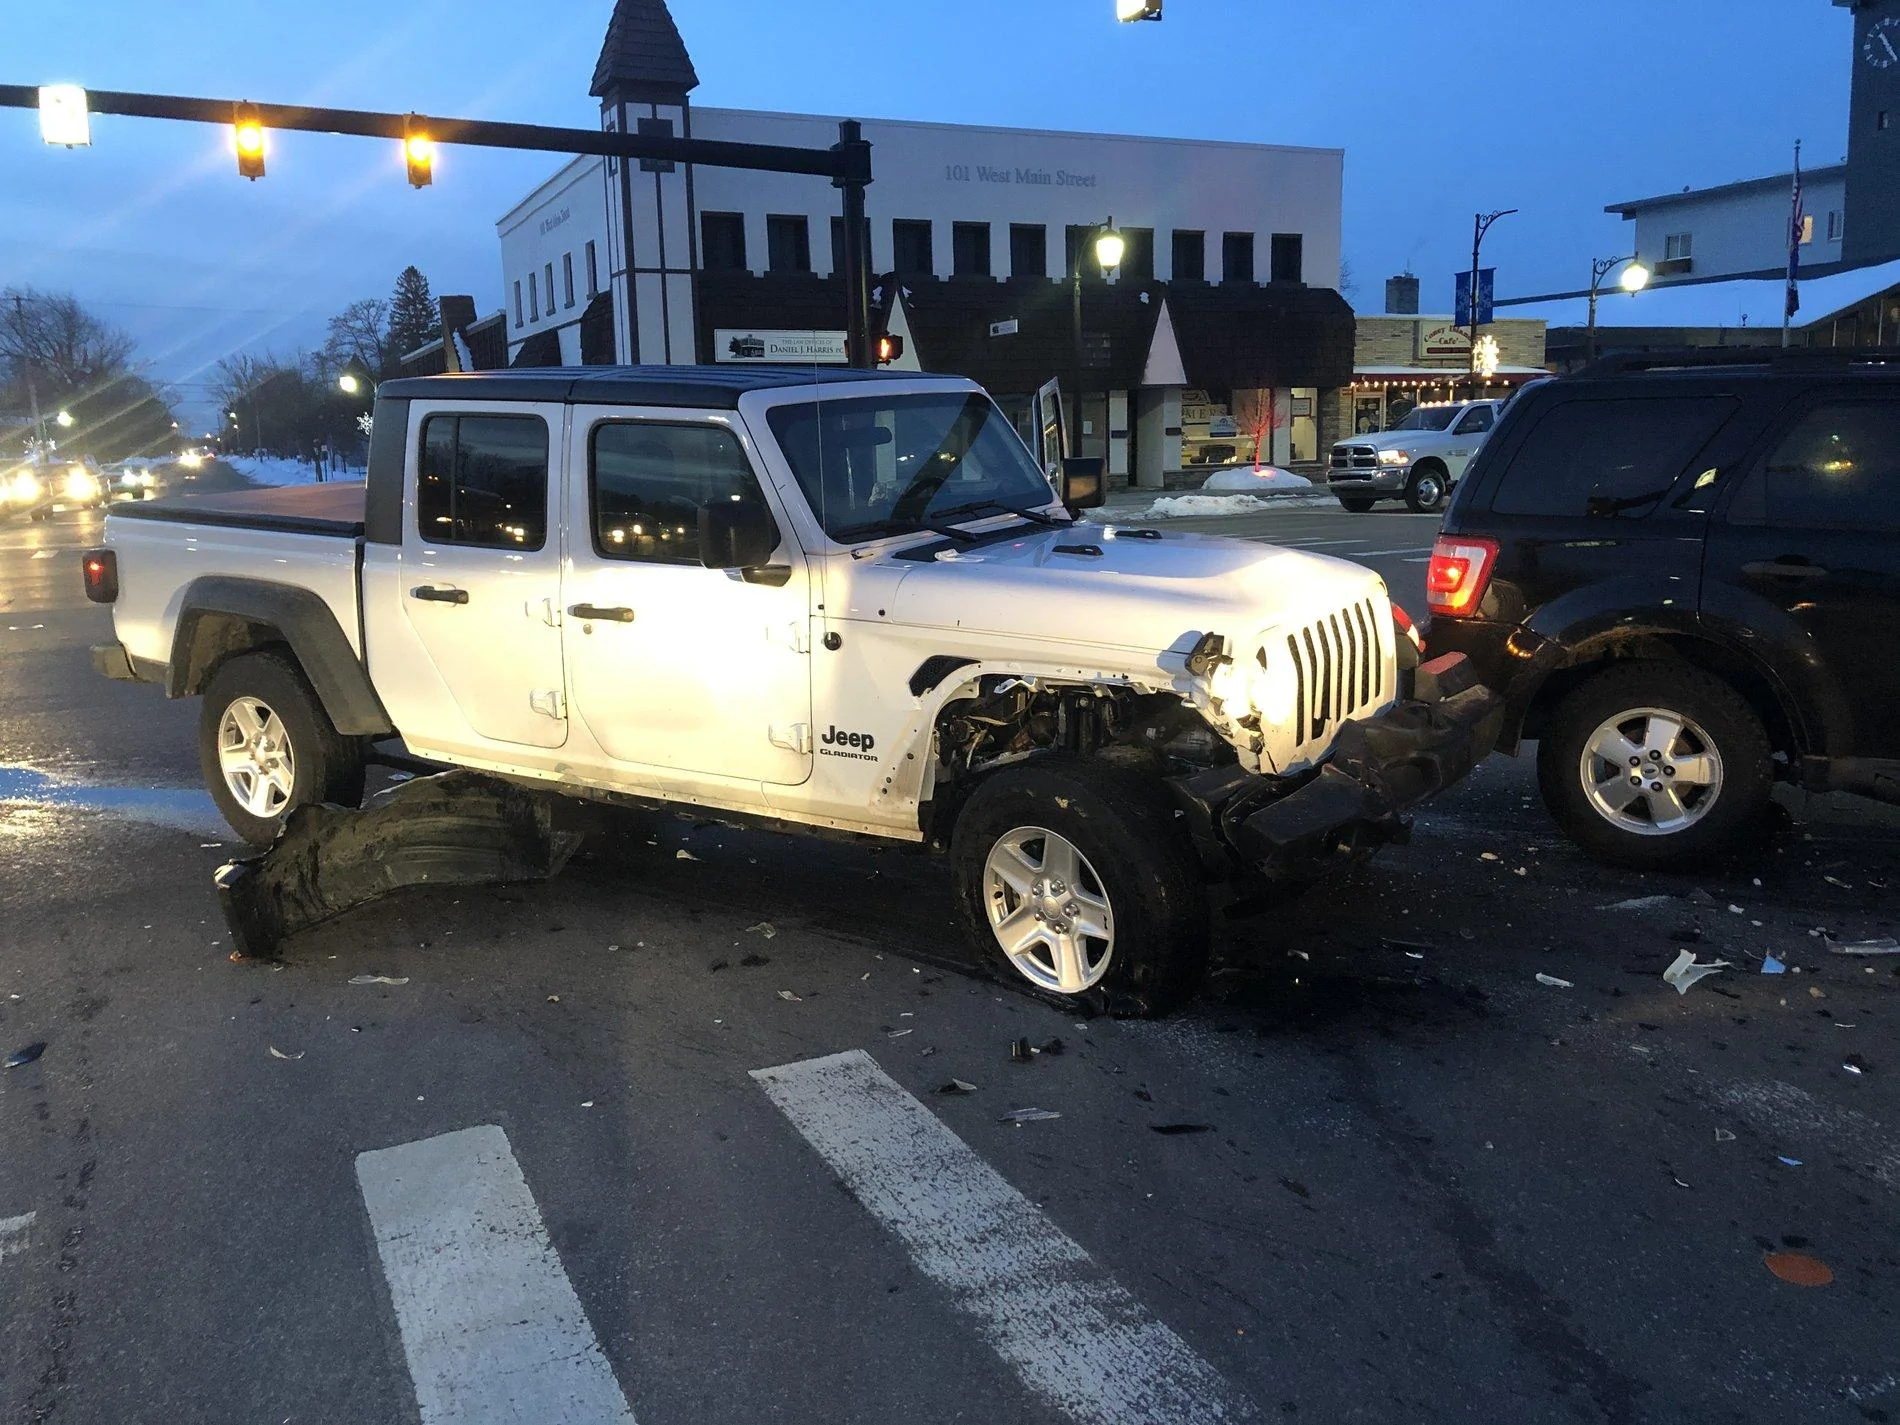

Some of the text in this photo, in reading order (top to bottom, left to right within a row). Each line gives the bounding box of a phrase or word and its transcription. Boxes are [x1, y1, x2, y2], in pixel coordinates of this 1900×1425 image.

[945, 164, 1097, 187] 101 West Main Street
[1424, 327, 1446, 342] Coney
[821, 725, 875, 752] Jeep
[820, 748, 879, 762] GLADIATOR
